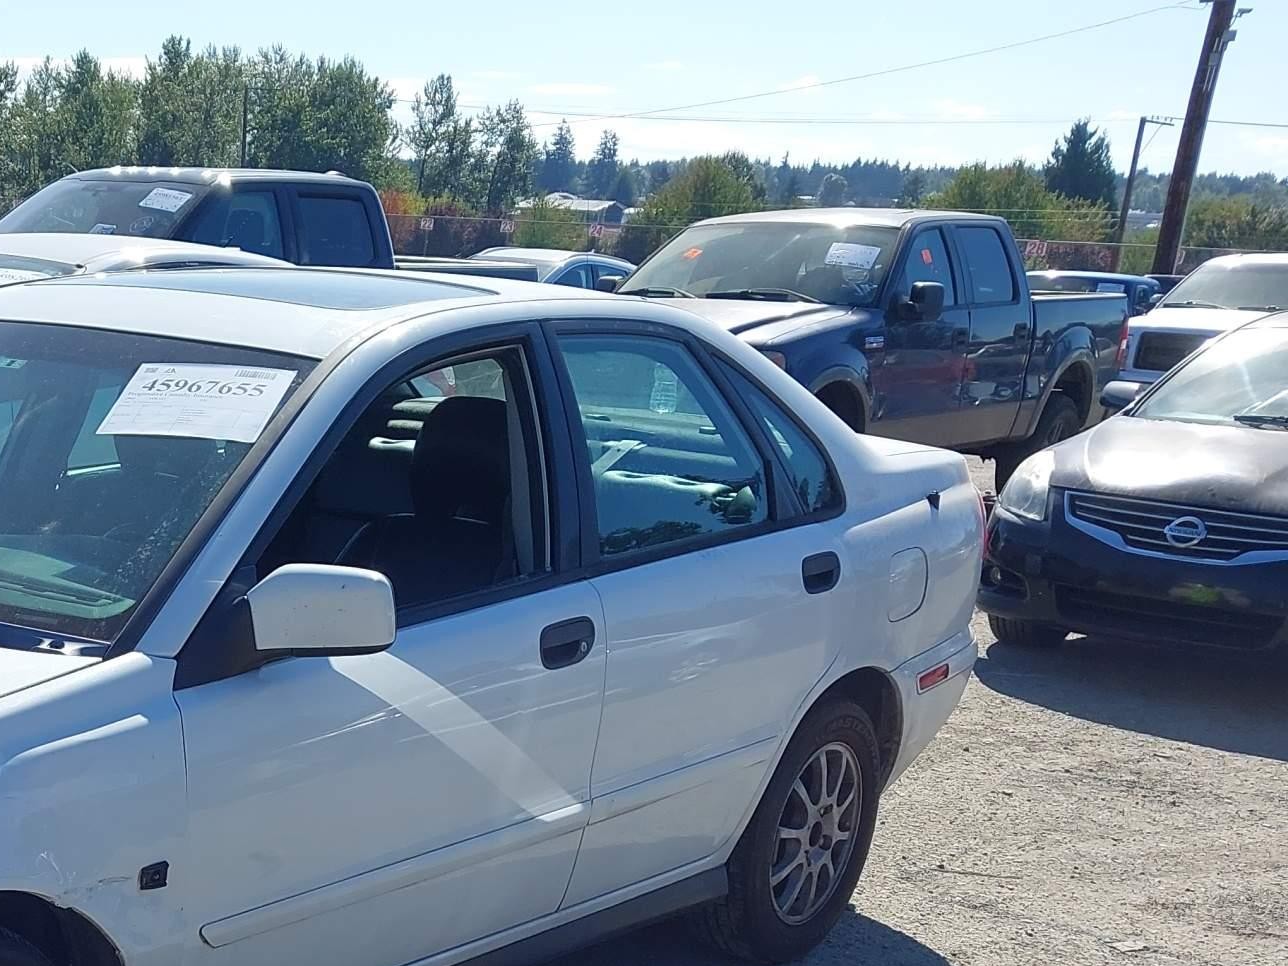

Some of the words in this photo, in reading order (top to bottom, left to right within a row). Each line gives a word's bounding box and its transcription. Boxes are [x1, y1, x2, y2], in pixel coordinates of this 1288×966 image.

[422, 218, 433, 229] 22
[502, 221, 514, 232] 23
[591, 225, 603, 237] 24
[1027, 241, 1045, 256] 28
[142, 378, 268, 397] 45967655
